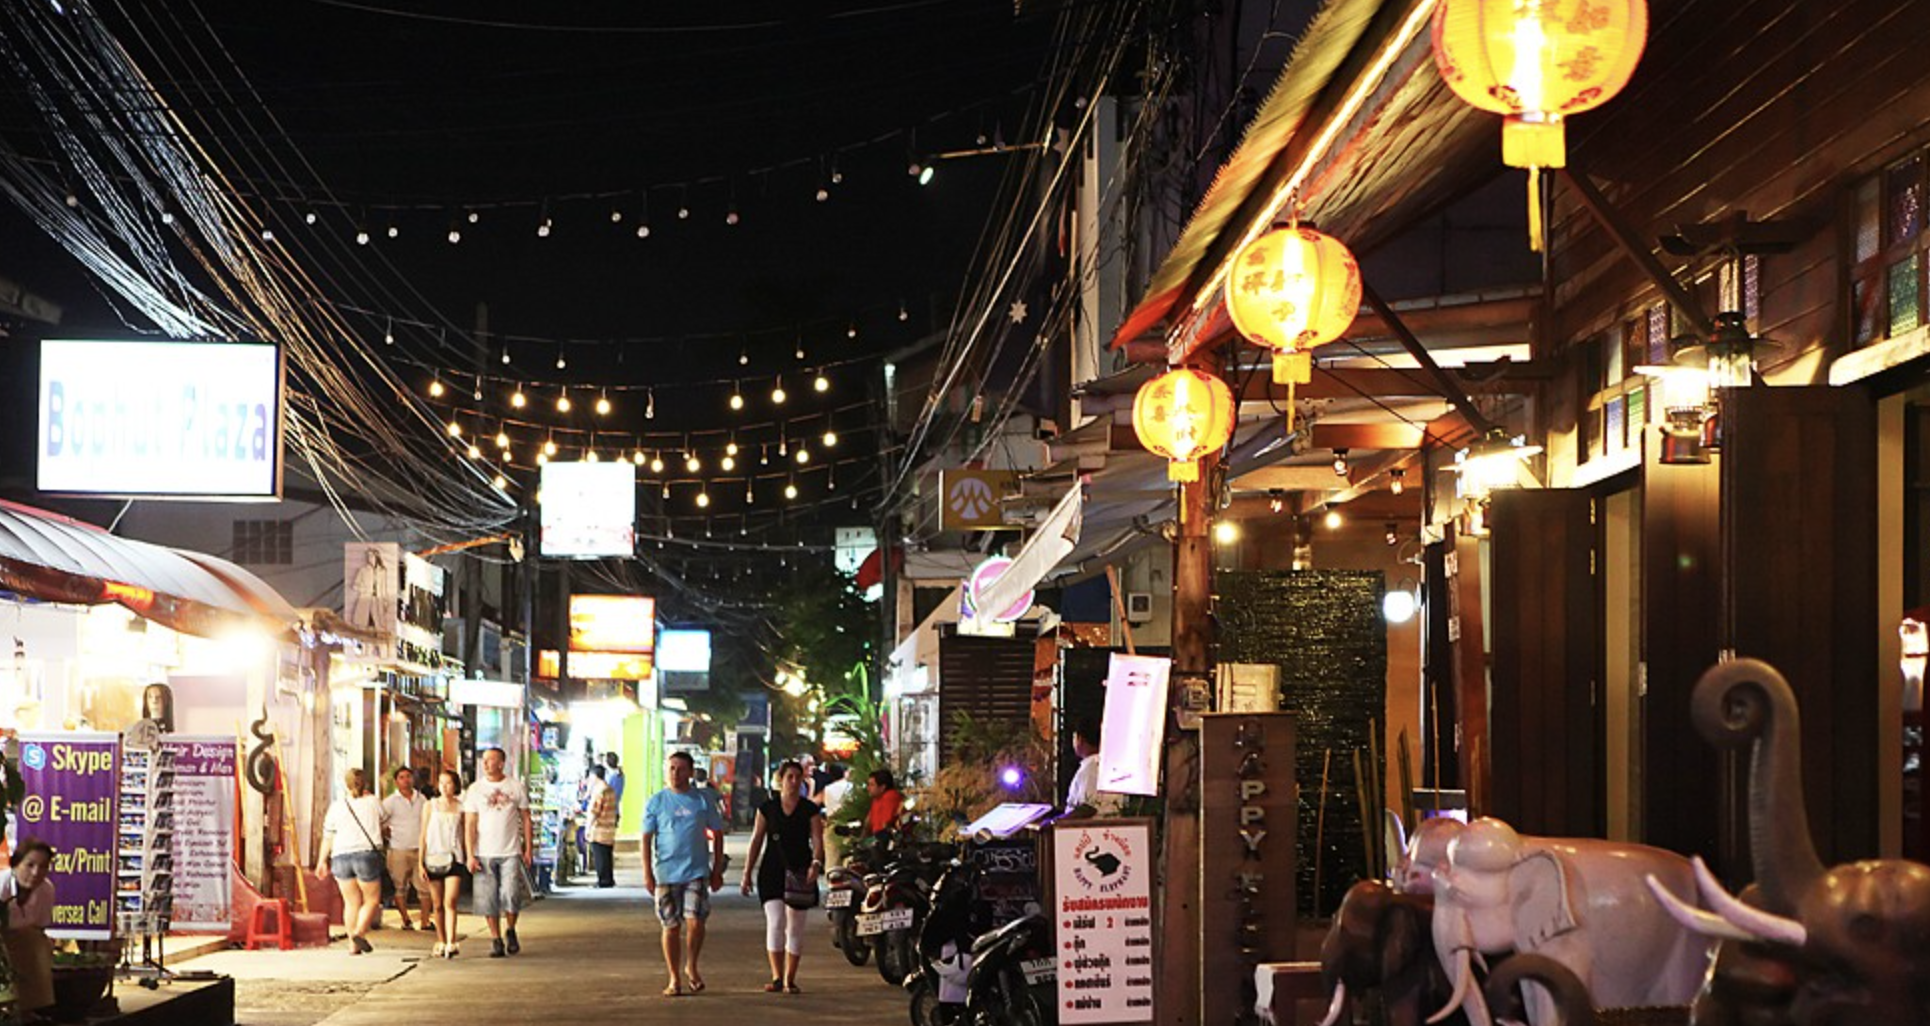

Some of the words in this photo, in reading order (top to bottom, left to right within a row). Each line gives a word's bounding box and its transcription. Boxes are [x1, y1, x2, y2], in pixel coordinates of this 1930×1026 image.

[180, 380, 268, 461] Plaza
[51, 744, 112, 776] Skype
[192, 743, 233, 763] Design
[22, 795, 44, 822] @
[51, 795, 111, 822] E-mail
[88, 899, 108, 924] Call
[1063, 894, 1148, 912] รับสมัครพนักงาน
[1106, 916, 1113, 929] 2
